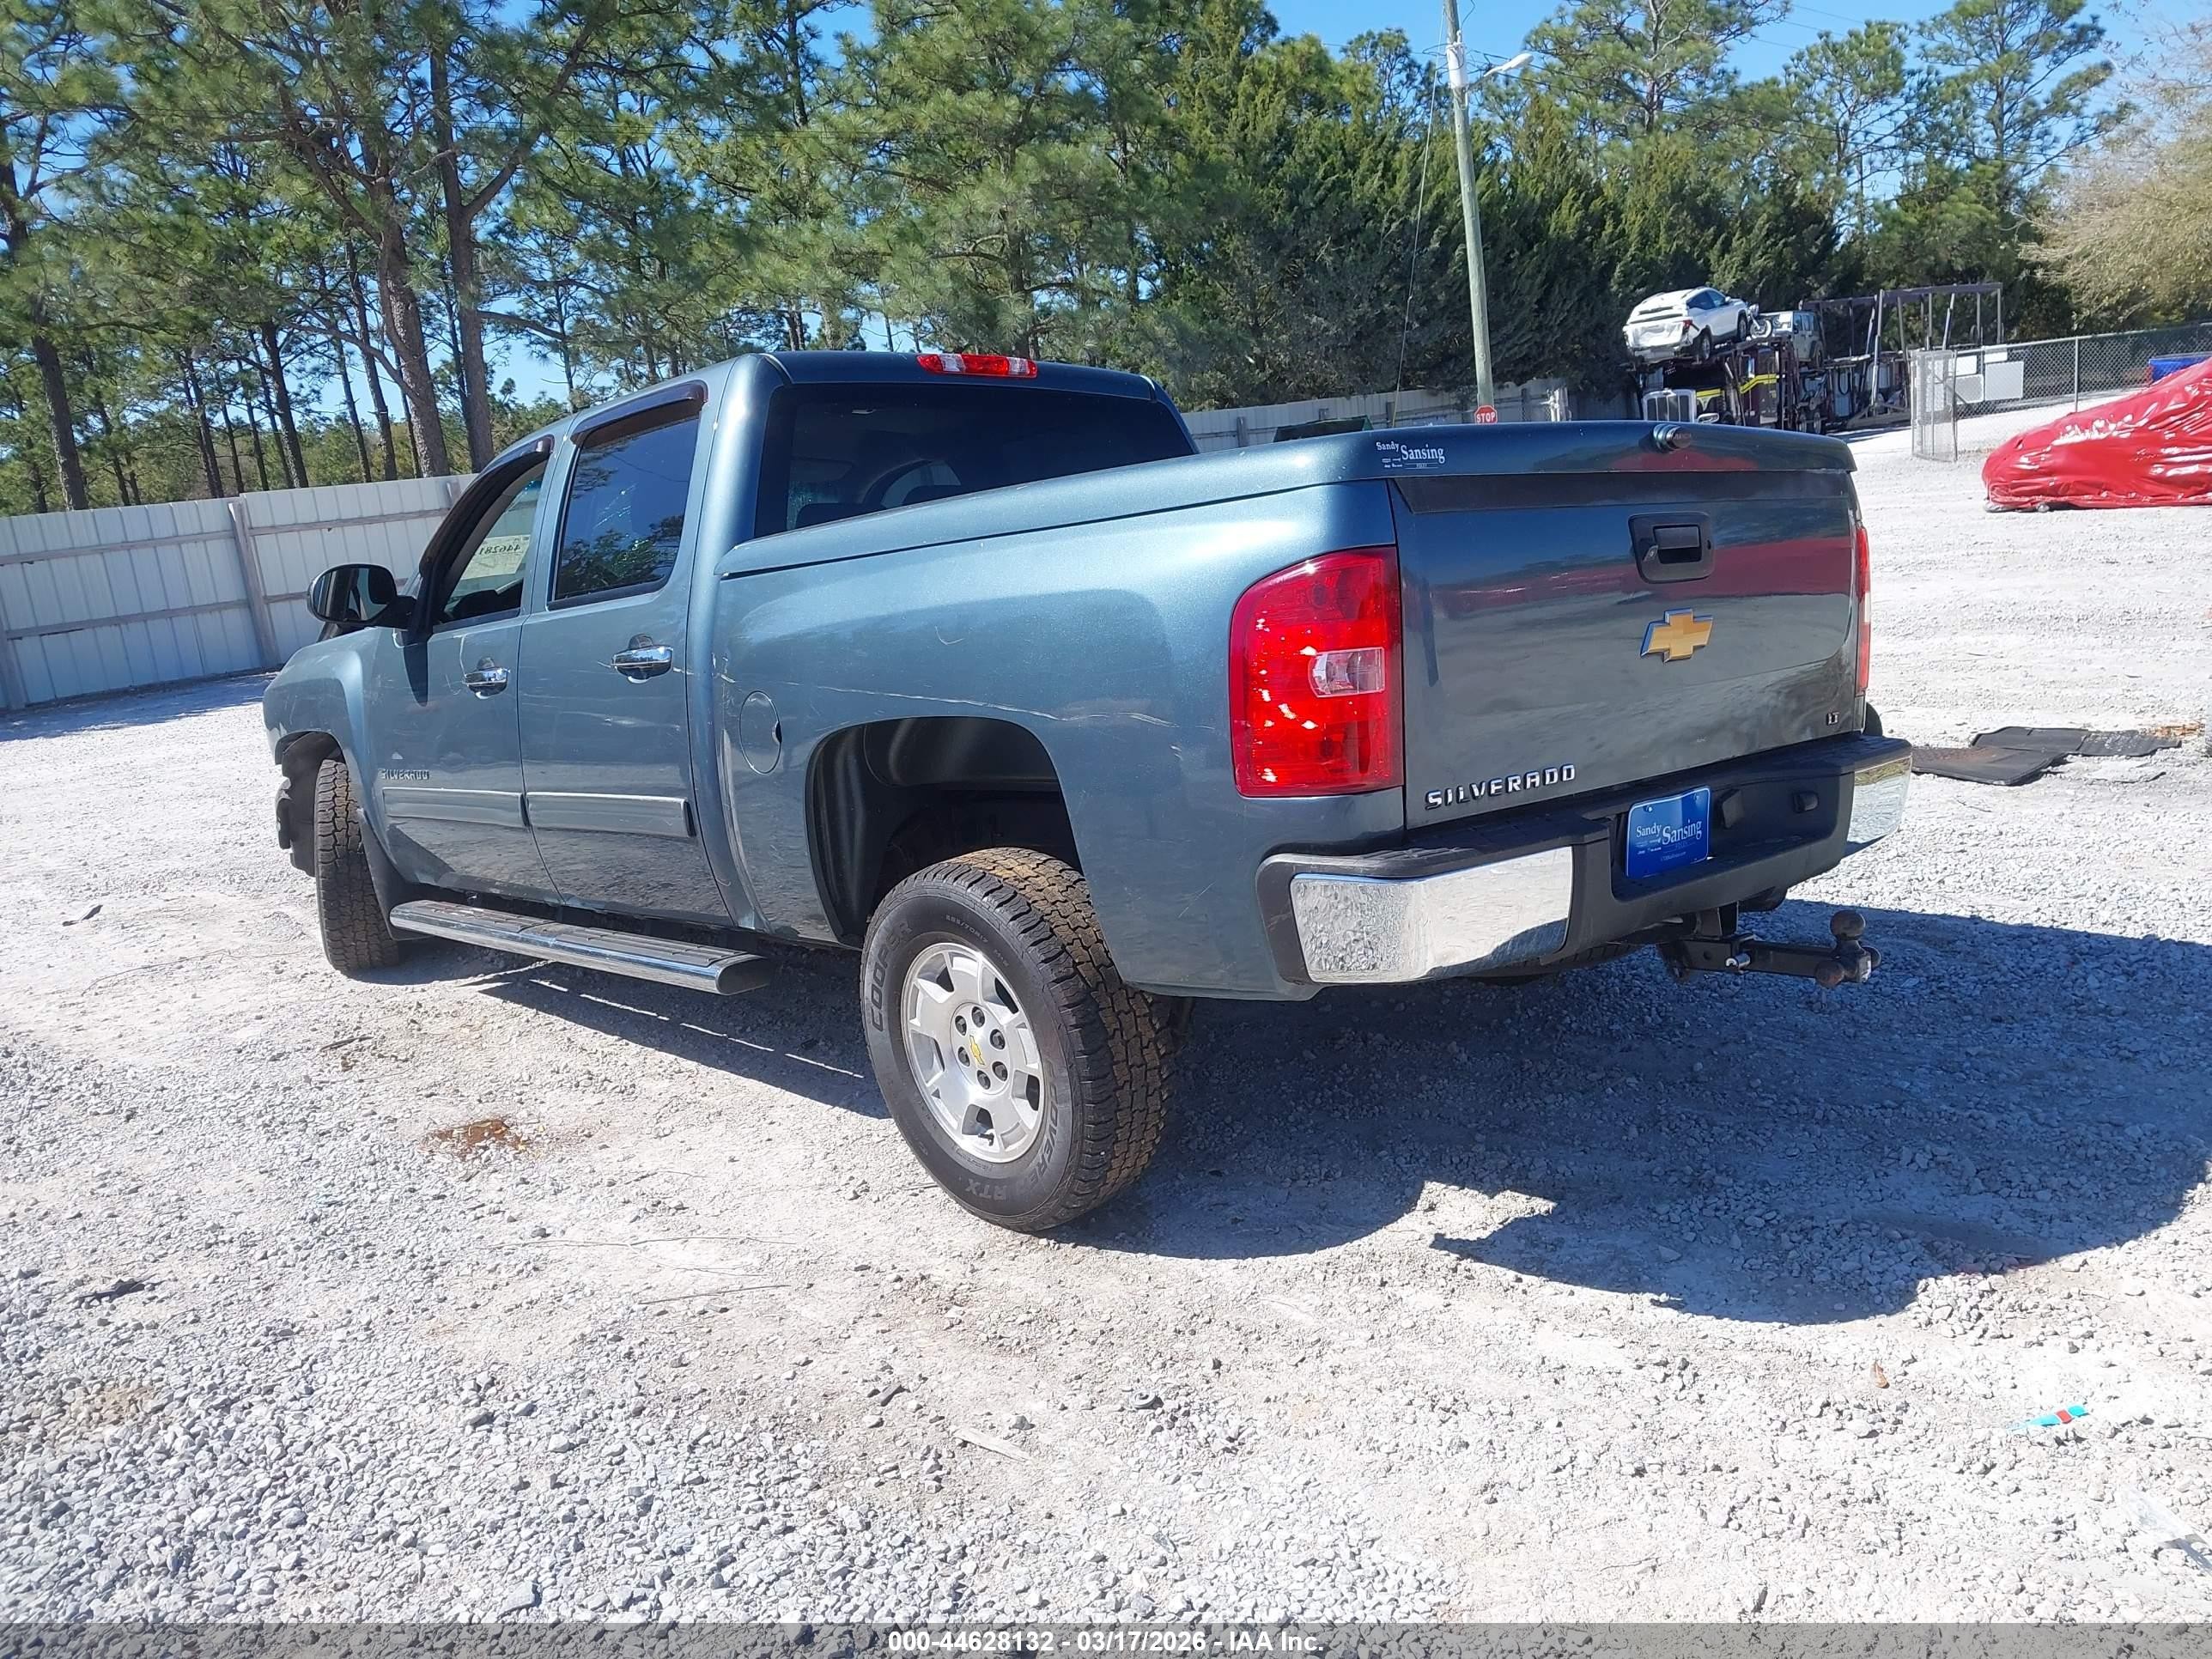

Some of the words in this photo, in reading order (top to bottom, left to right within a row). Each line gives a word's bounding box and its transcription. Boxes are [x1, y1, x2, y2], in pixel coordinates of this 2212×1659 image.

[1476, 412, 1496, 423] STOP
[1376, 441, 1400, 453] Sandy
[1400, 443, 1445, 464] Sansing
[1826, 711, 1840, 726] LT
[1425, 763, 1576, 810] SILVERADO
[1635, 822, 1662, 838] Sandy
[1662, 818, 1703, 846] Sansing
